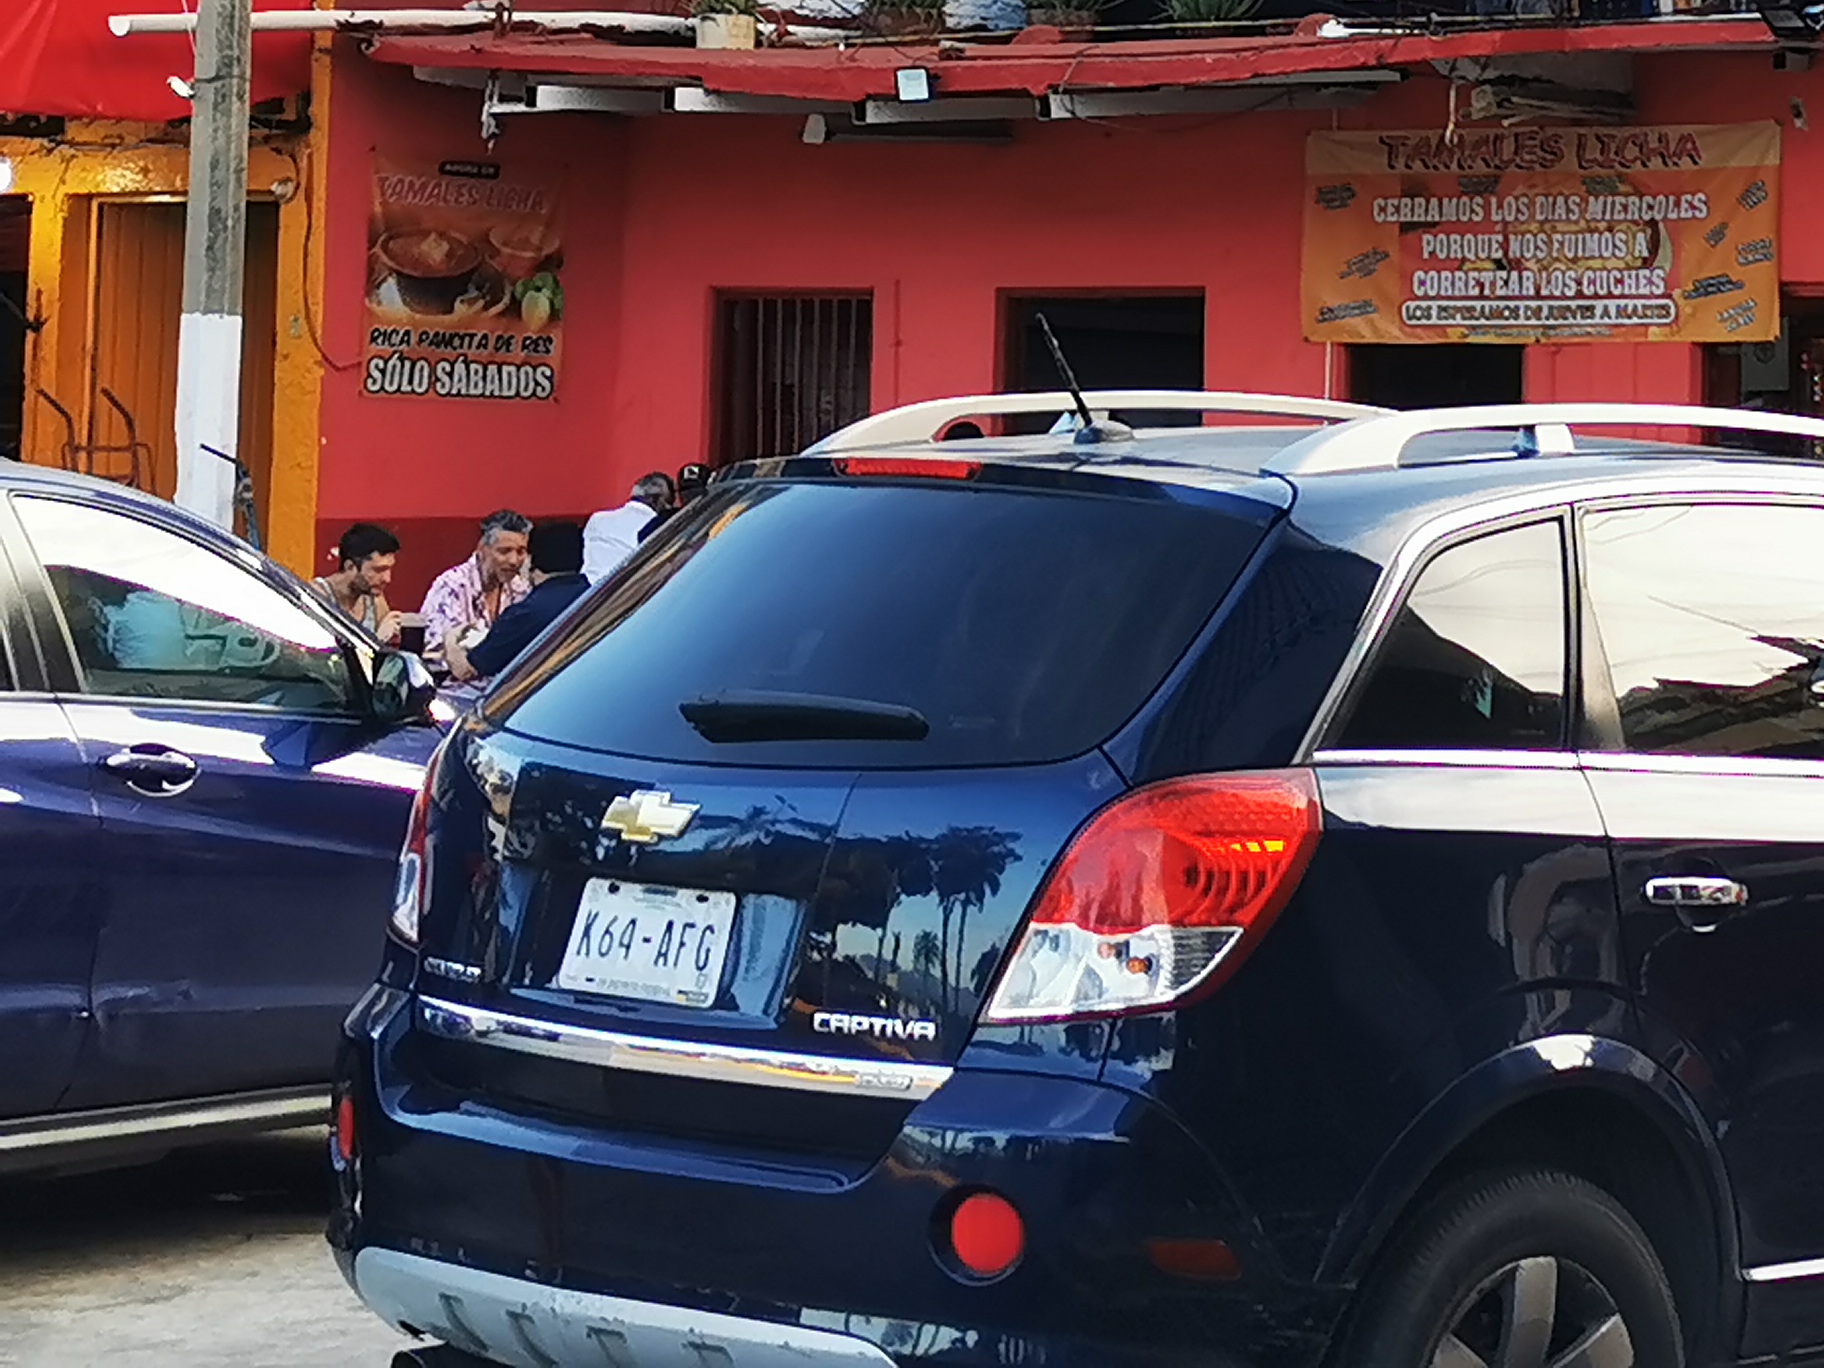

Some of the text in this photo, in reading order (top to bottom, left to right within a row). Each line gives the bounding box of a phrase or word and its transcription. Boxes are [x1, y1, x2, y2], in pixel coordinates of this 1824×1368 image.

[1379, 131, 1703, 171] TAMALES LICHA
[1373, 196, 1485, 223] CERRAMOS
[1490, 195, 1530, 223] LOS
[1535, 195, 1580, 221] DIAS
[1585, 192, 1710, 221] MIERCOLES
[1421, 232, 1649, 260] PORQUE NOS FUIMOS A
[1412, 270, 1535, 297] CORRETEAR
[1540, 270, 1577, 296] LOS
[1583, 269, 1665, 296] CUCHES
[1405, 304, 1433, 321] LOS
[369, 327, 411, 348] RICA
[494, 334, 515, 353] DE
[521, 335, 554, 355] RES
[366, 351, 553, 399] SÓLO SÁBADOS
[813, 1011, 936, 1042] CAPTIVA
